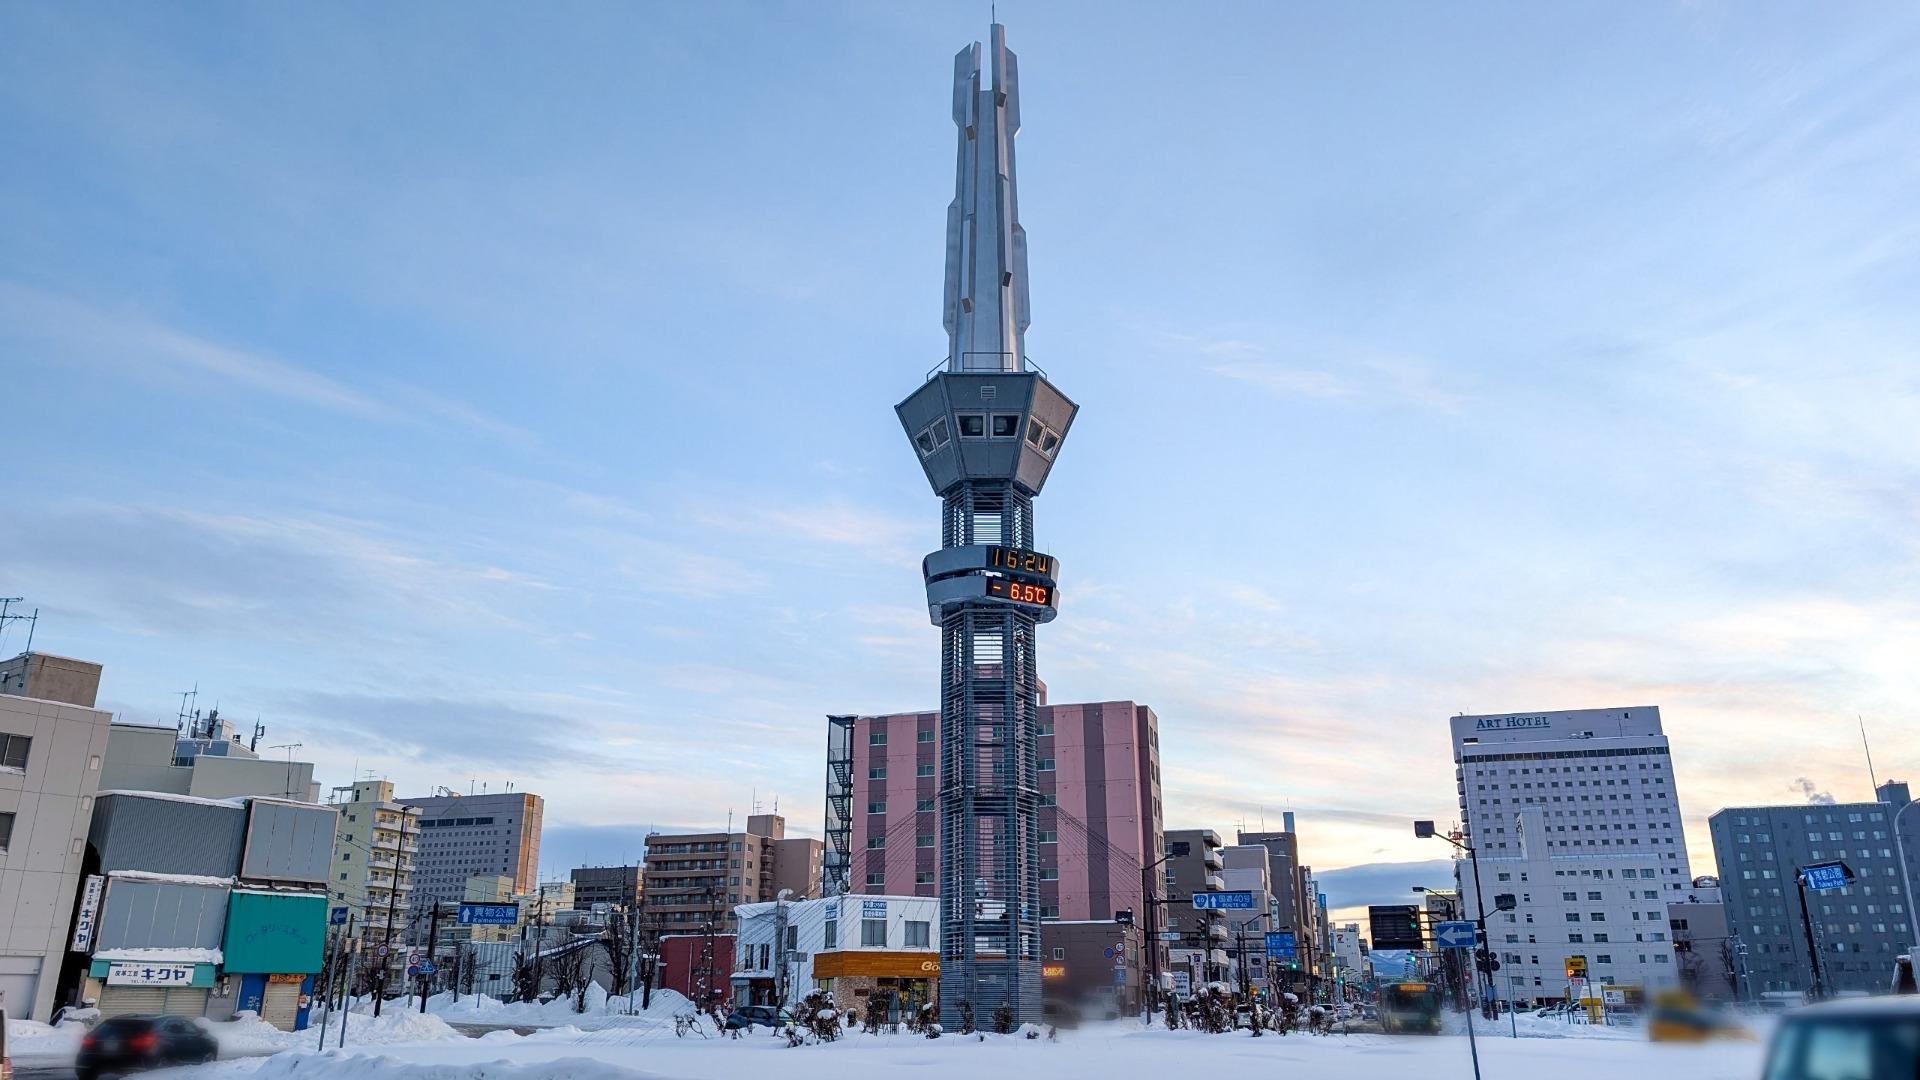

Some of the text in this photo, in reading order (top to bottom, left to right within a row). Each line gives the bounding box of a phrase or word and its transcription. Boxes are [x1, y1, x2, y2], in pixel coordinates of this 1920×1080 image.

[994, 548, 1047, 572] 16:24
[1476, 716, 1550, 729] ART HOTEL
[77, 908, 92, 943] キクヤ
[920, 960, 941, 972] Go
[1567, 968, 1575, 977] P
[141, 968, 187, 981] キクヤ
